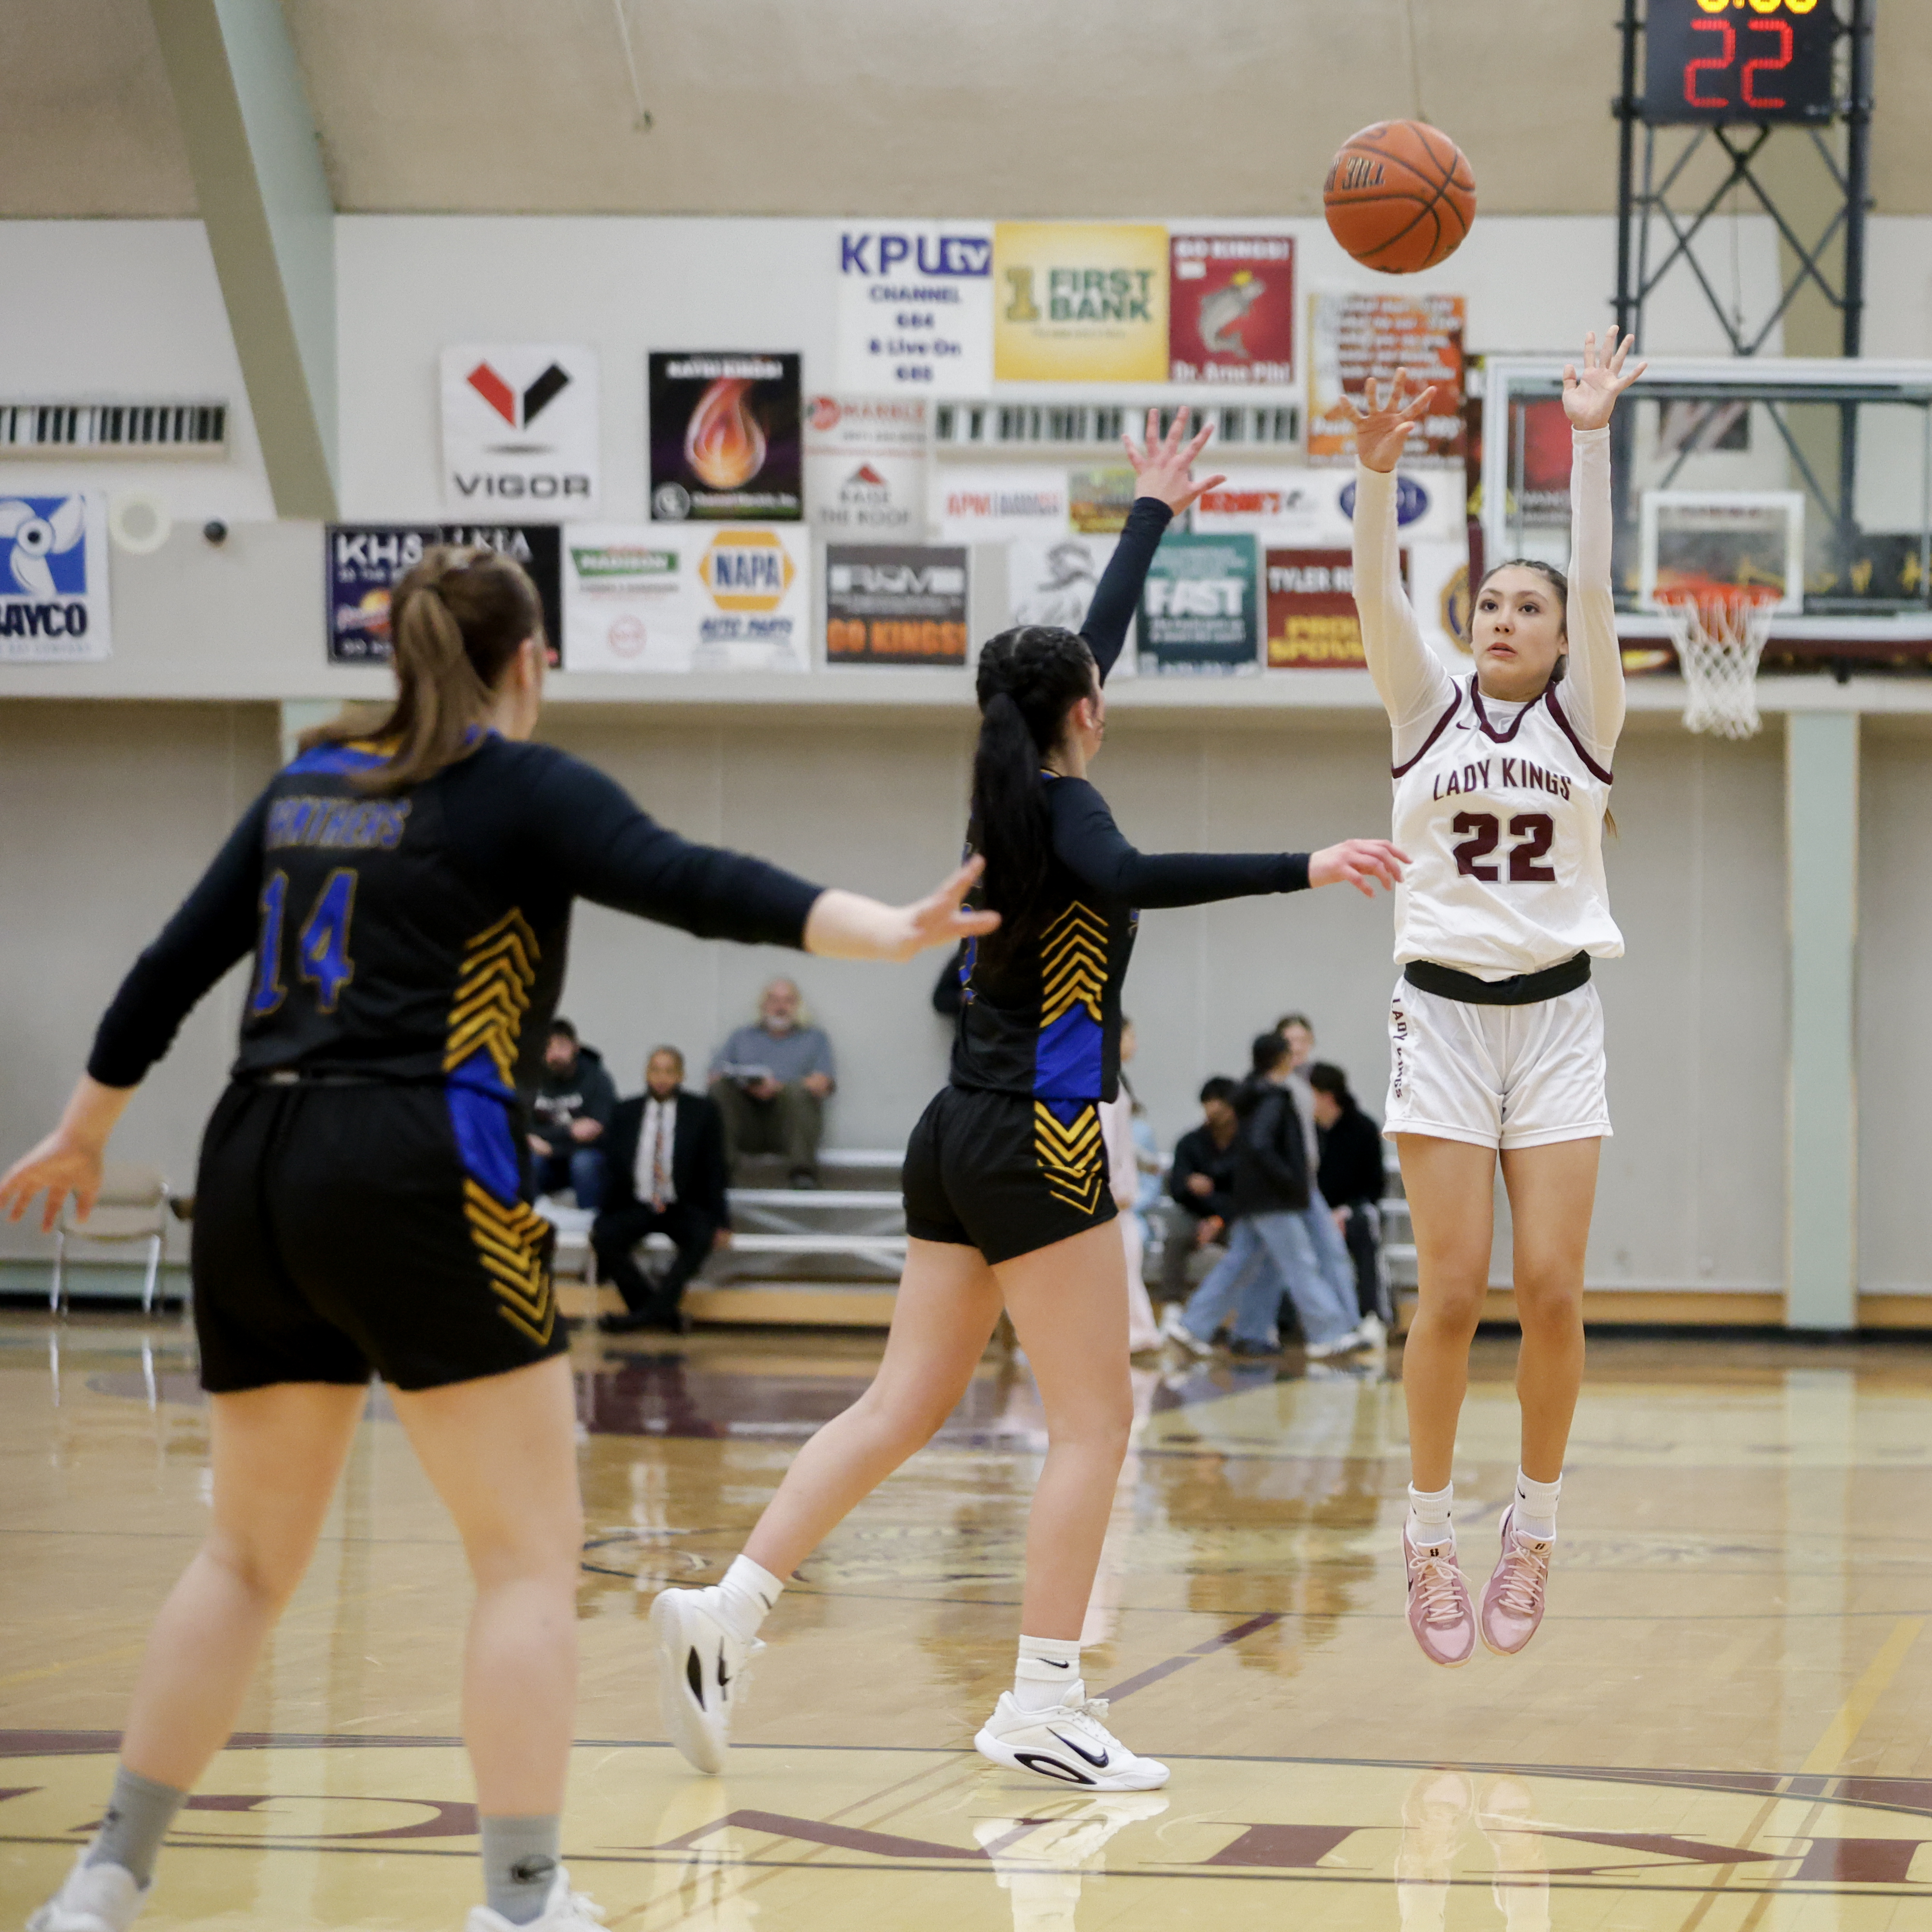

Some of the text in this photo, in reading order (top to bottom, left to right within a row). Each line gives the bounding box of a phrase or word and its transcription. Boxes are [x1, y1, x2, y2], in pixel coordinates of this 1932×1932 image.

[1683, 18, 1793, 108] 22
[869, 284, 960, 304] CHANNEL
[1049, 269, 1156, 292] FIRST
[1049, 297, 1152, 322] BANK
[887, 340, 926, 356] Live
[933, 341, 962, 356] On
[453, 473, 591, 498] VIGOR
[716, 553, 781, 588] NAPA
[1269, 566, 1330, 594] TYLER
[1145, 578, 1245, 617] FAST
[0, 602, 87, 637] AYCO
[1433, 758, 1572, 802] LADY KINGS
[1450, 810, 1557, 884] 22
[252, 867, 358, 1017] 14
[1391, 998, 1408, 1041] LADY
[0, 1787, 1932, 1883] KING
